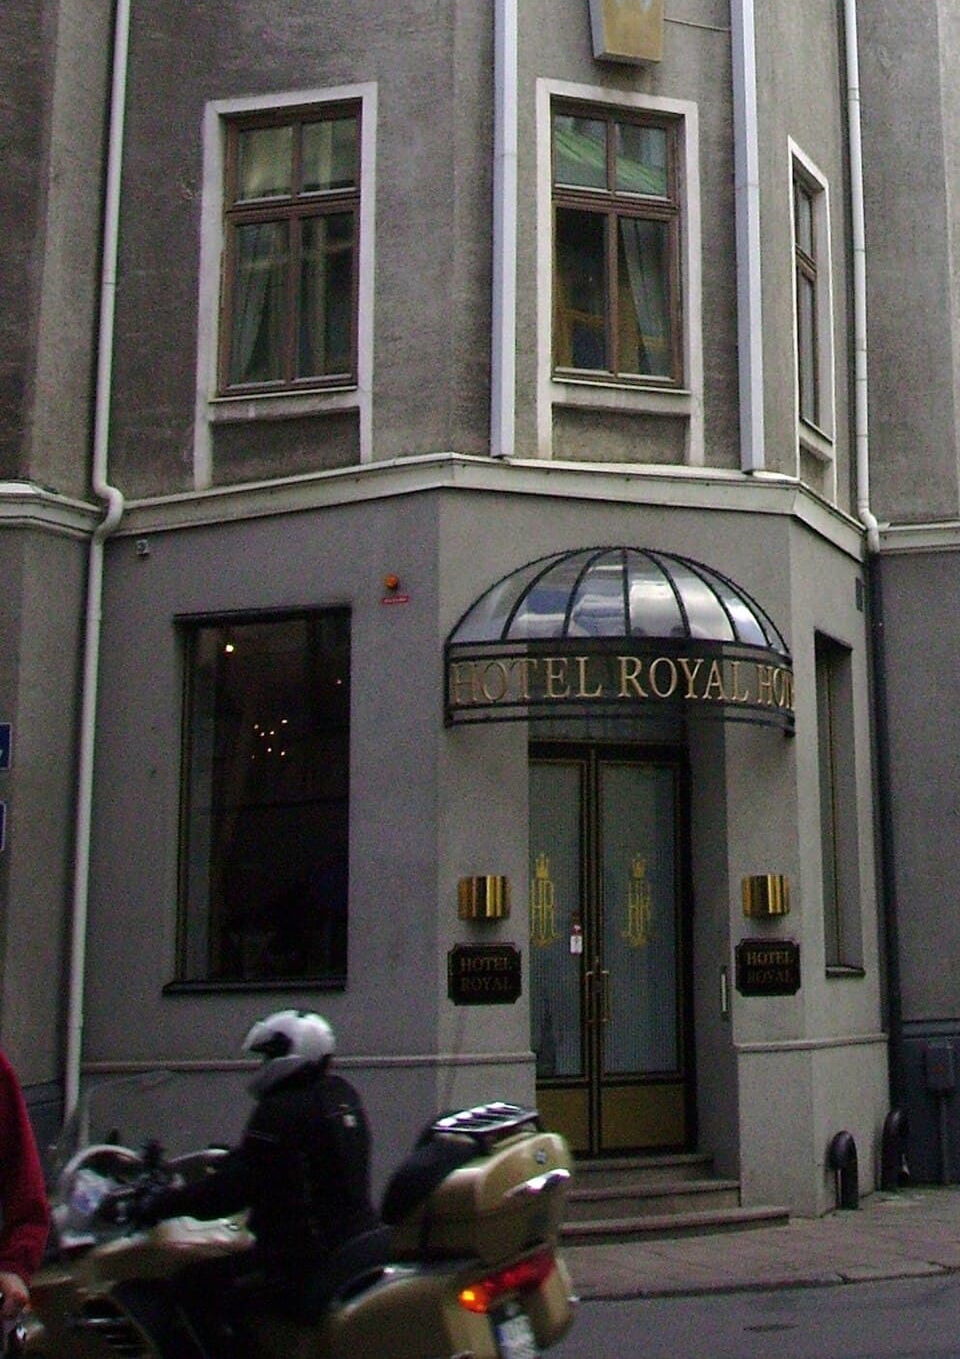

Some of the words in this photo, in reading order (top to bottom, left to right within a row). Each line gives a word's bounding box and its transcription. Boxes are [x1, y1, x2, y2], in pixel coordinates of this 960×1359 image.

[451, 656, 602, 704] HOTEL
[617, 655, 750, 701] ROYAL
[460, 956, 512, 972] HOTEL
[746, 950, 793, 966] HOTEL
[460, 976, 513, 993] ROYAL
